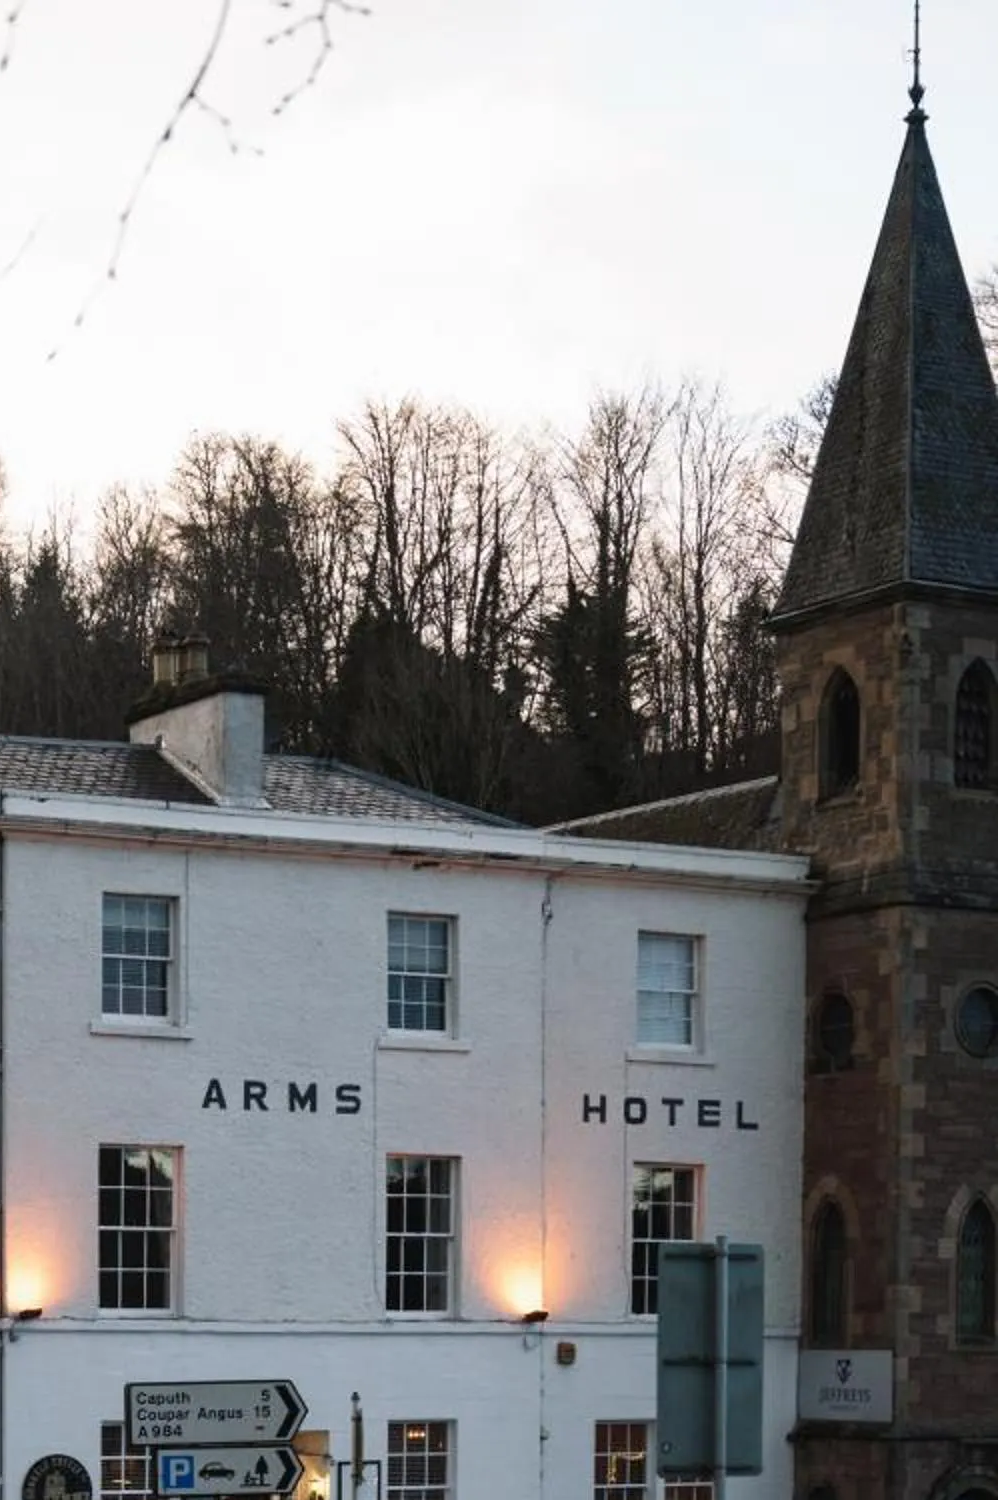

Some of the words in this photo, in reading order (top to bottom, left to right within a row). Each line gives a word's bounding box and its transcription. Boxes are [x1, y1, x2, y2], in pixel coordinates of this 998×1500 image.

[201, 1077, 362, 1115] ARMS
[582, 1093, 760, 1131] HOTEL
[136, 1391, 192, 1406] Caputh
[260, 1388, 272, 1402] 5
[136, 1408, 191, 1423] Coupar
[196, 1406, 244, 1422] Angus
[253, 1404, 271, 1419] 15
[168, 1457, 191, 1487] P
